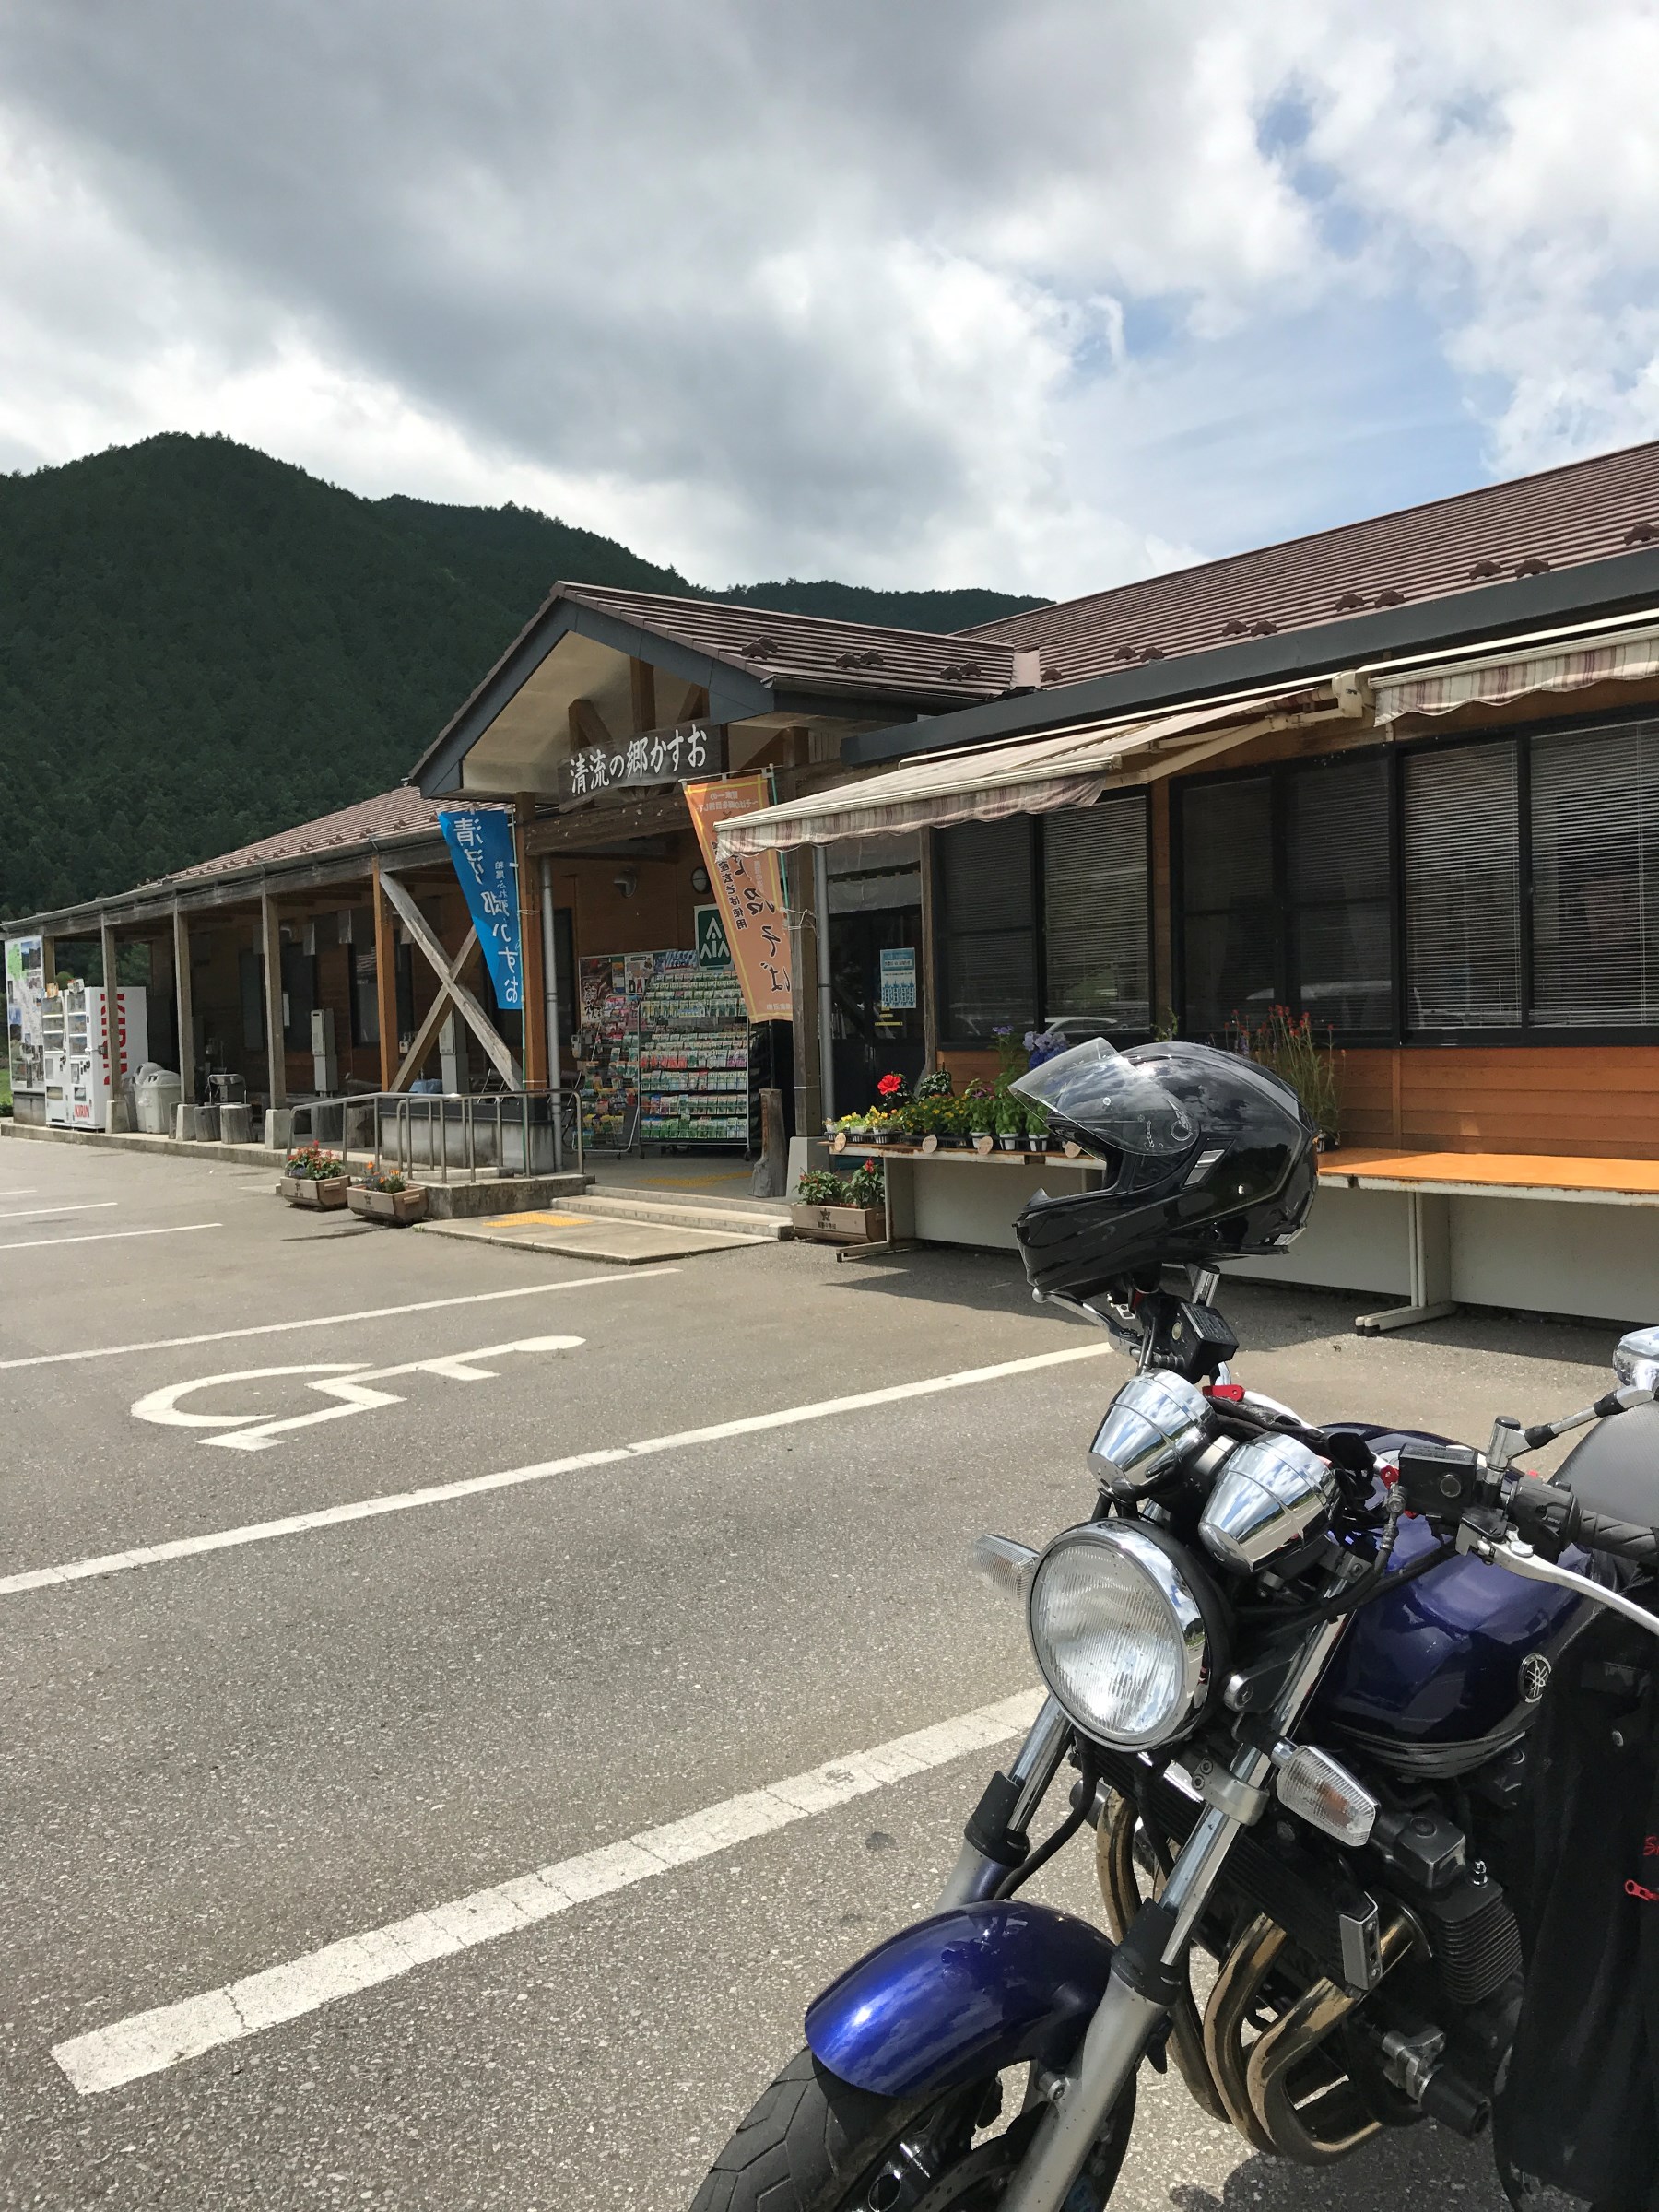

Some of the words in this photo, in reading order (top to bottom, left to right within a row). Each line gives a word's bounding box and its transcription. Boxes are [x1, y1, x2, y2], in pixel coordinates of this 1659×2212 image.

[570, 724, 707, 794] 清流の郷かすお
[75, 1104, 89, 1118] KIRIN
